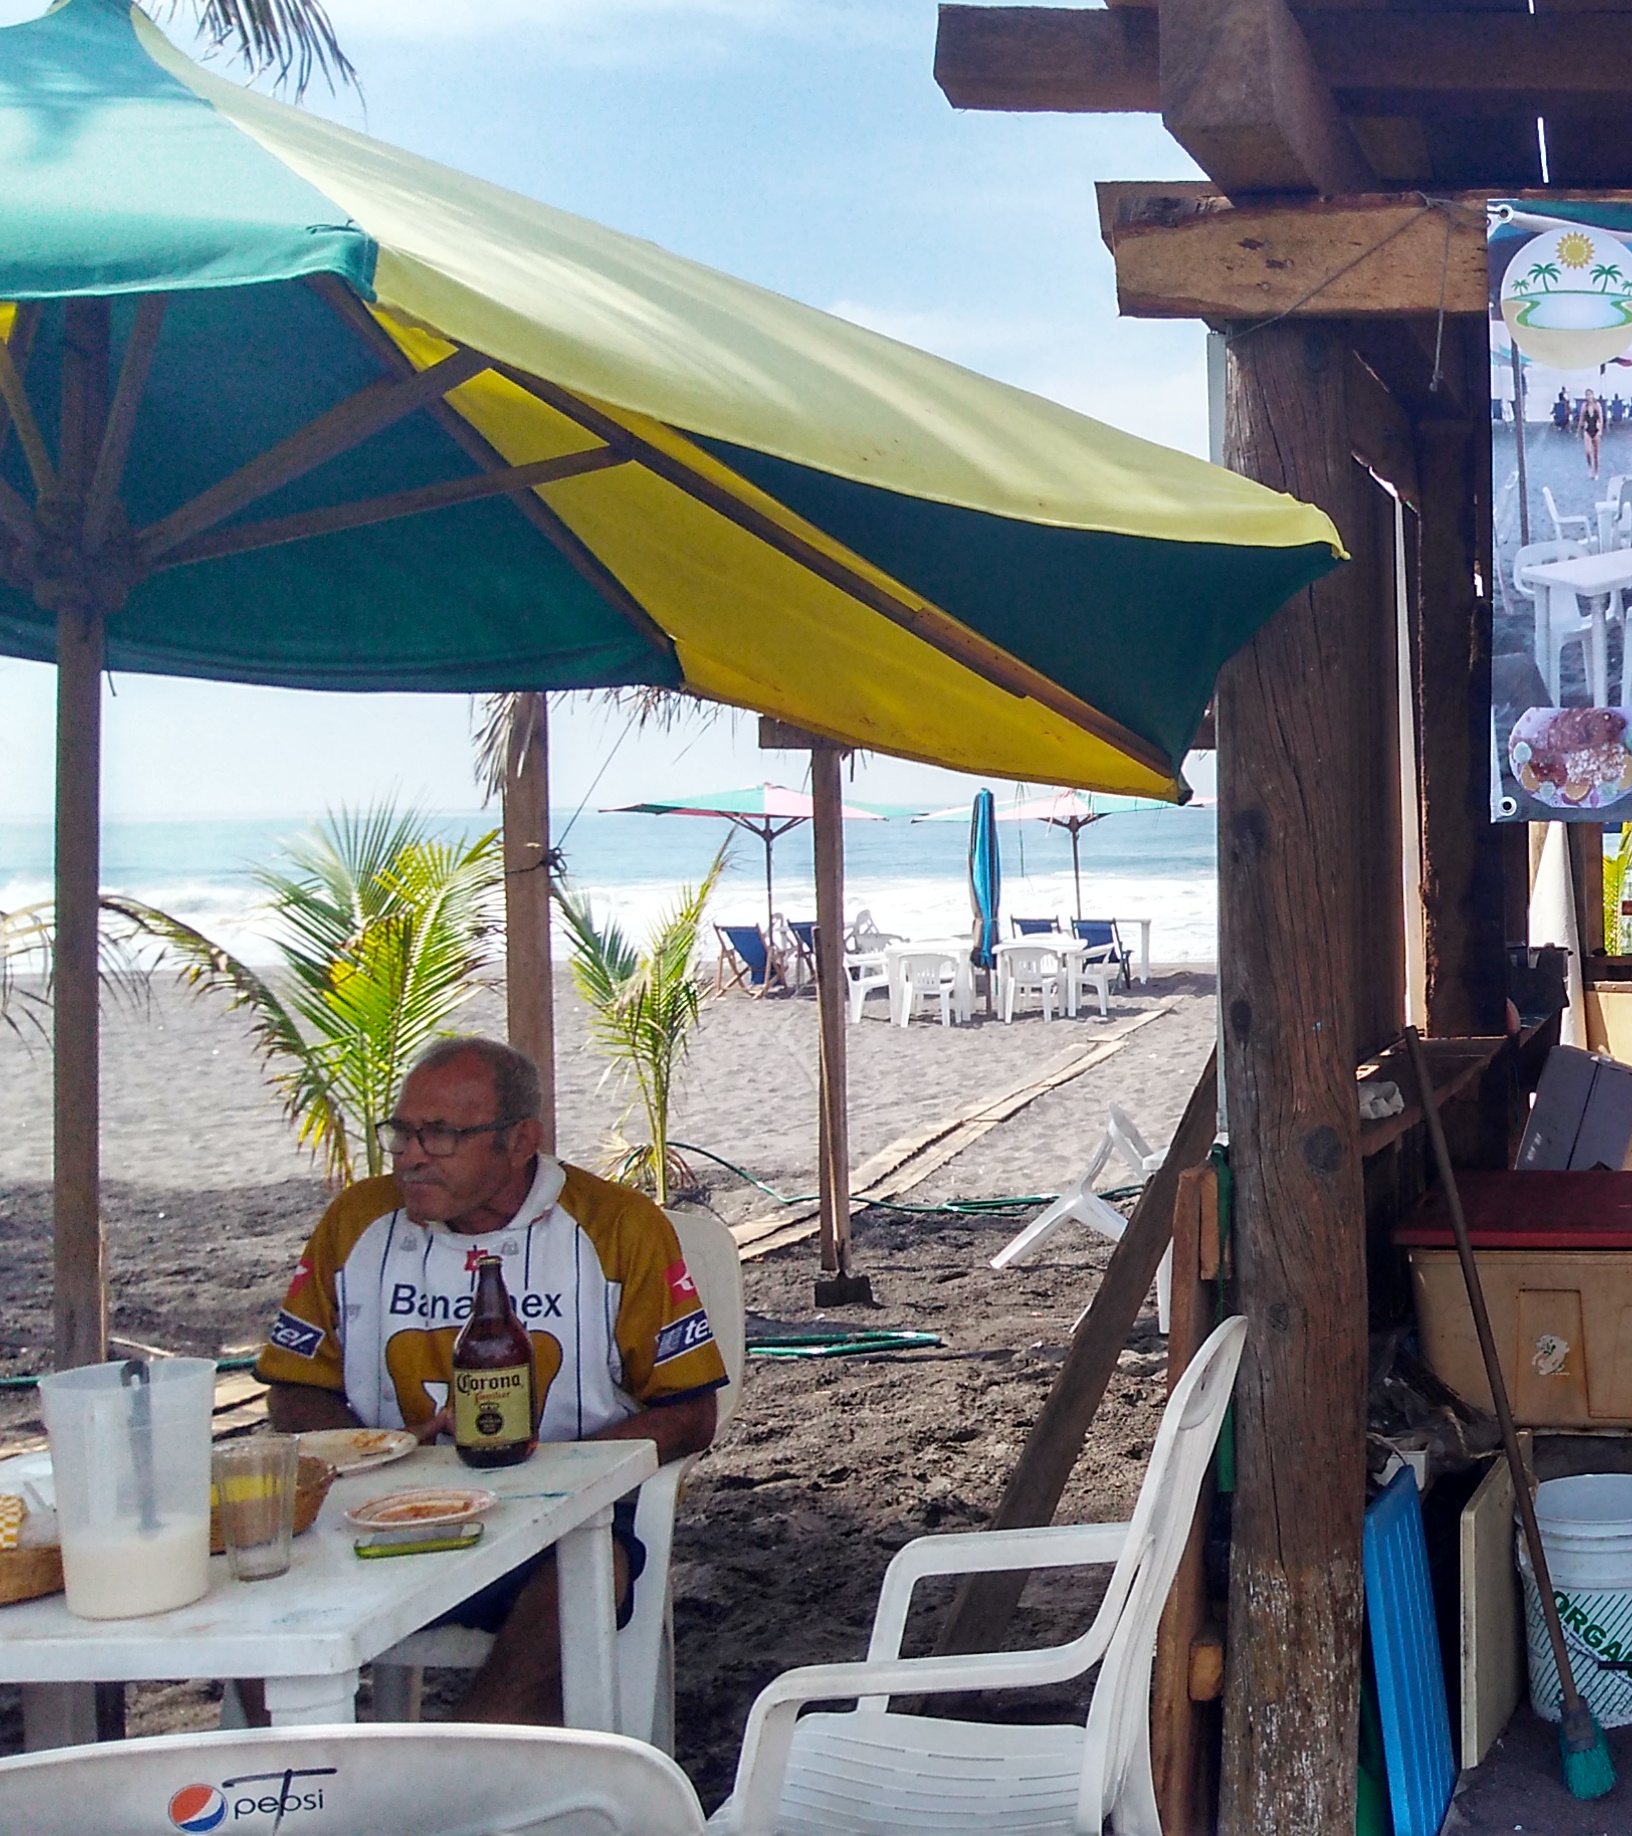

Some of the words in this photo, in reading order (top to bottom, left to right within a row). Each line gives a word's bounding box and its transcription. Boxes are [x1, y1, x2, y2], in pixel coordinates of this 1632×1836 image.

[389, 1283, 563, 1320] Banaex
[457, 1373, 522, 1396] Corona
[234, 1788, 324, 1820] pepsi
